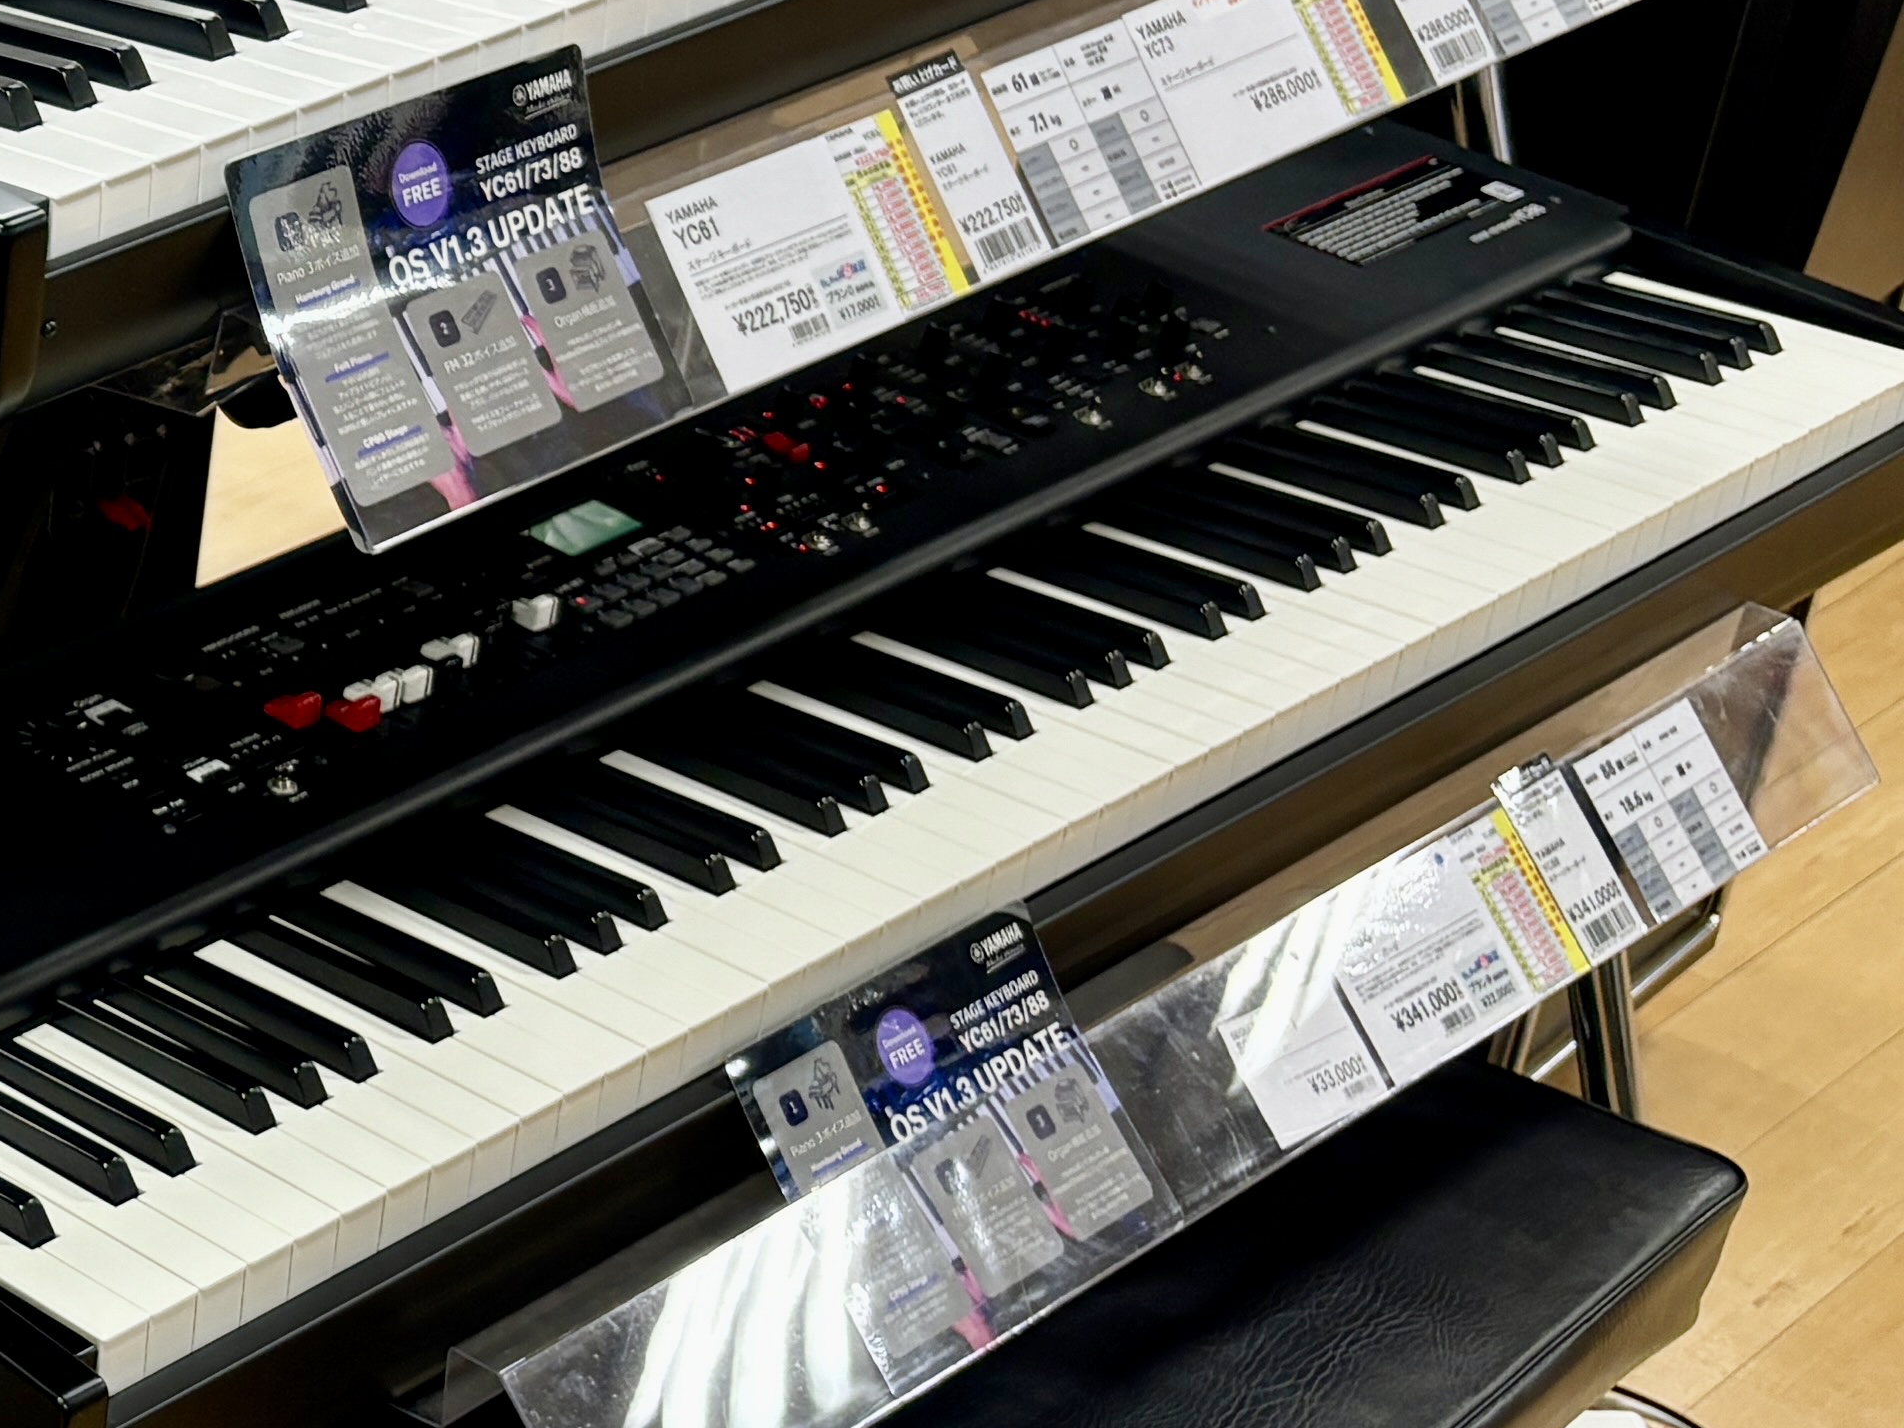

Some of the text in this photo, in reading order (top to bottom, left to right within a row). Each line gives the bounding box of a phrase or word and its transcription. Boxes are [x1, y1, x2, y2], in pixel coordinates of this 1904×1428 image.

[1134, 8, 1187, 42] YAMAHA
[1143, 35, 1176, 60] YC73
[524, 68, 572, 102] YAMAHA
[1008, 72, 1030, 93] 61
[1248, 69, 1317, 113] ¥286,000
[1027, 110, 1050, 135] 7.1
[474, 122, 579, 175] STAGE KEYBOARD
[397, 160, 438, 185] Download
[479, 145, 584, 203] YC61/73/88
[400, 177, 443, 207] FREE
[663, 194, 719, 225] YAMAHA
[672, 215, 723, 250] YC61
[954, 195, 1026, 236] ¥222,750
[386, 182, 596, 291] OS V1.3 UPDATE
[276, 265, 306, 286] Piano
[730, 286, 816, 338] ¥222,750
[978, 920, 1024, 958] YAMAHA
[948, 968, 1041, 1030] STAGE KEYBOARD
[1390, 979, 1460, 1037] ¥341,000
[958, 988, 1051, 1053] YC61/73/88
[887, 1037, 926, 1070] FREE
[886, 1020, 1072, 1144] OS V1.3 UPDATE
[1306, 1049, 1363, 1101] ¥33,000
